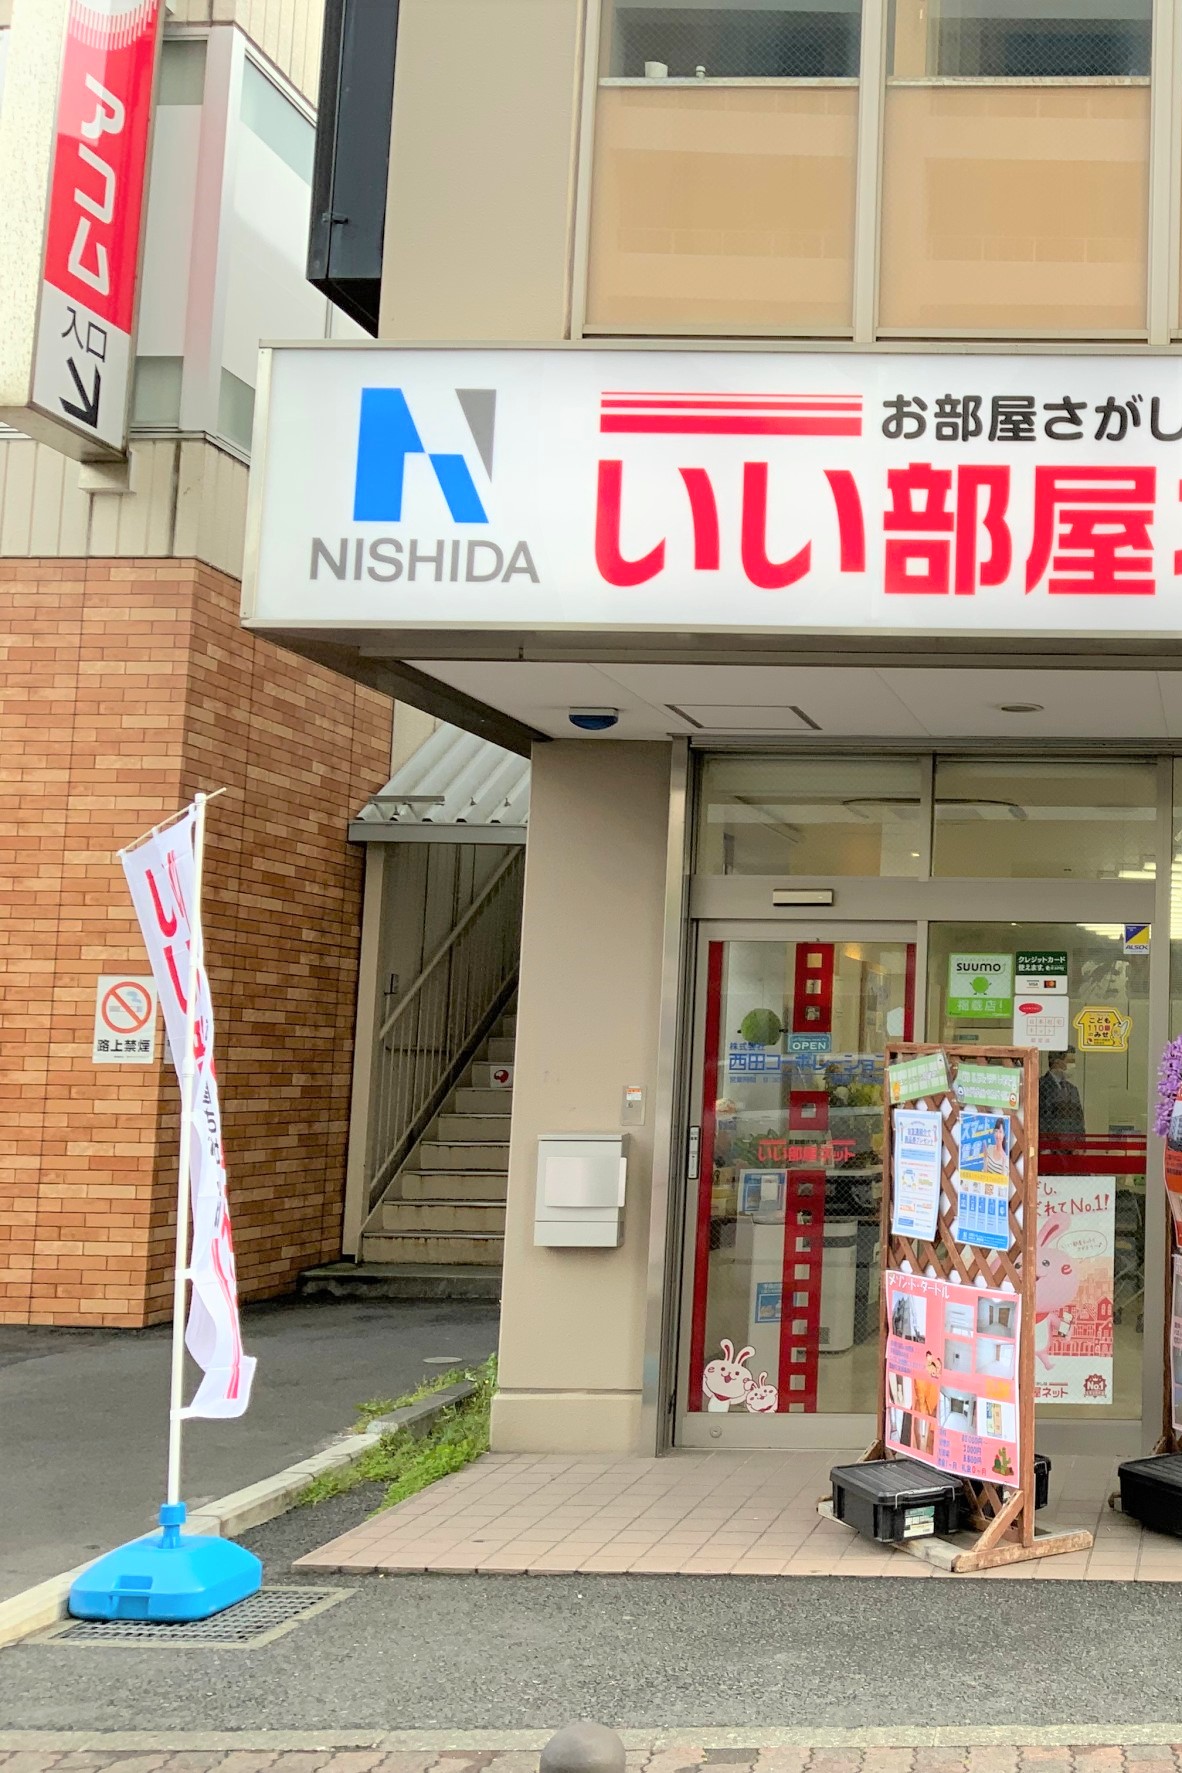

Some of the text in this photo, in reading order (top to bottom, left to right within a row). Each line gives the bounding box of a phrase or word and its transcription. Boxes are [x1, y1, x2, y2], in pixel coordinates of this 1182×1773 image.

[60, 306, 108, 363] 入口
[309, 537, 540, 583] NISHIDA
[1018, 956, 1066, 964] クレジットカード
[792, 1041, 826, 1050] OPEN
